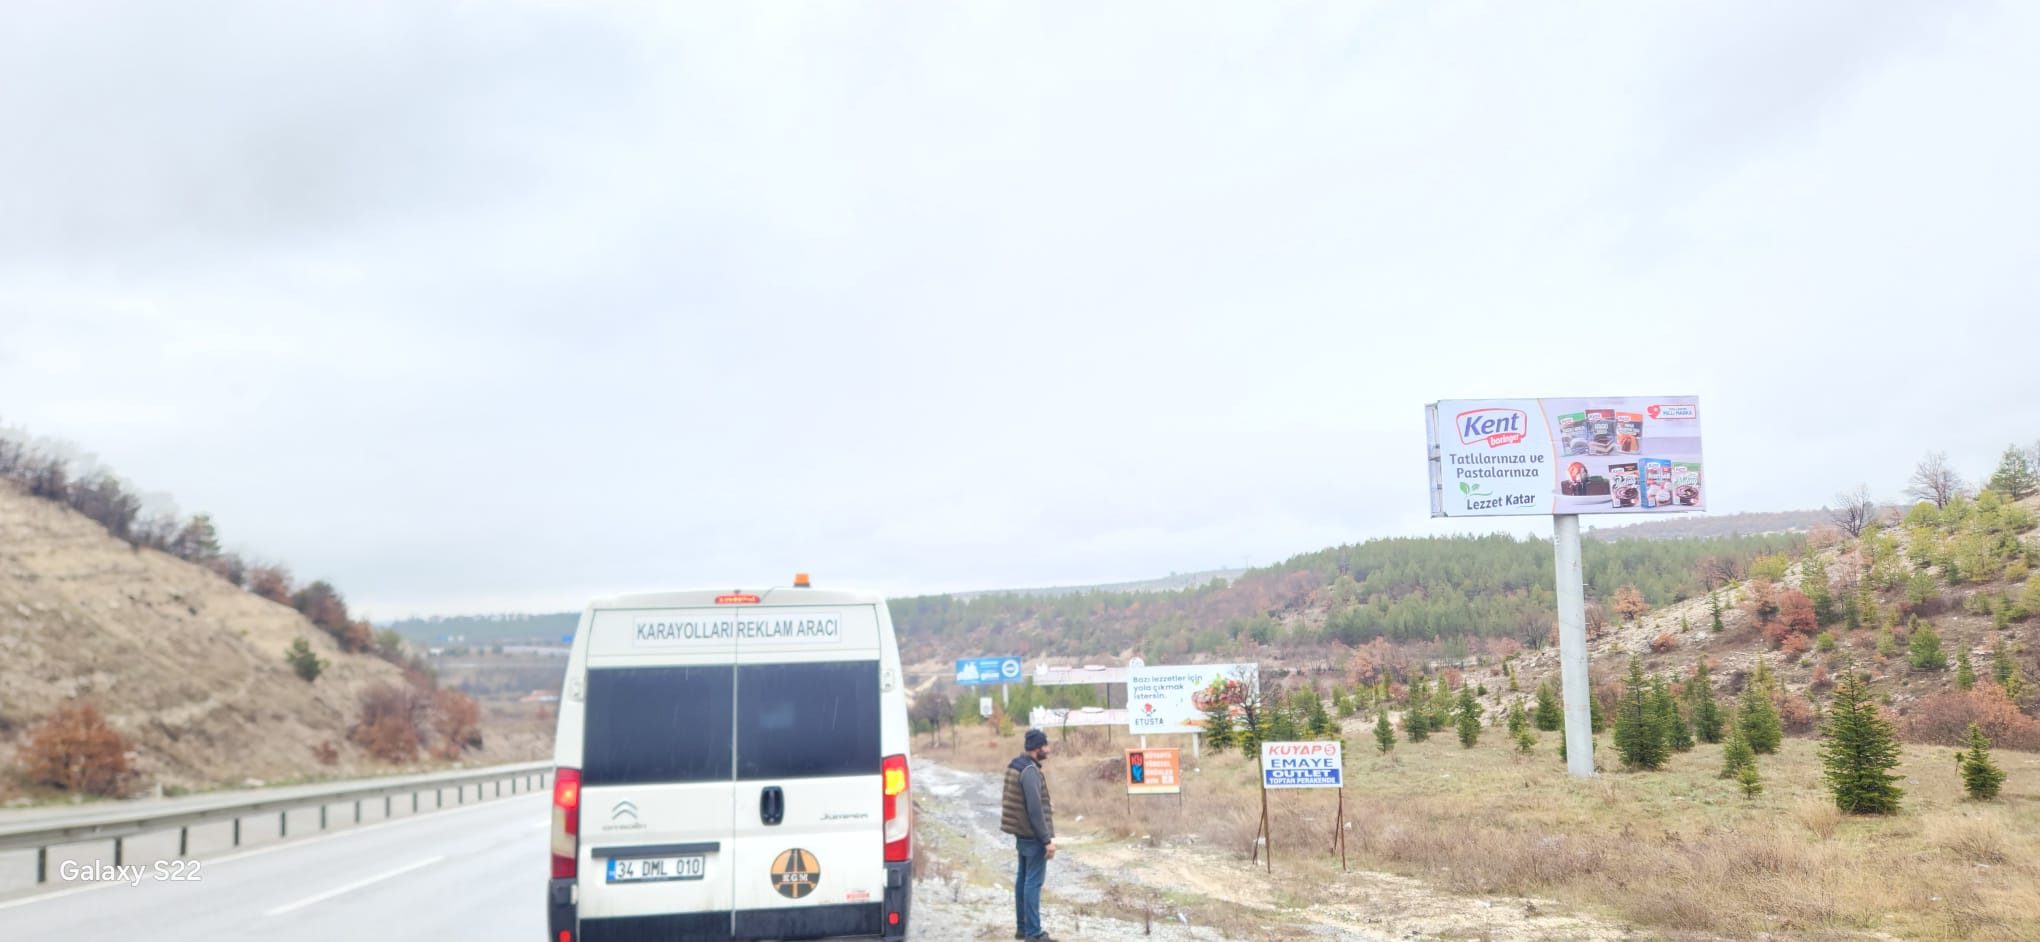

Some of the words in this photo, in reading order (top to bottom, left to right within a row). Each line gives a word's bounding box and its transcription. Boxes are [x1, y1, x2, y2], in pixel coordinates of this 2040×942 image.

[1463, 412, 1519, 437] Kent
[1449, 452, 1526, 465] Tatlılarınıza
[1529, 454, 1544, 463] ve
[1456, 466, 1539, 479] Pastalarınıza
[1466, 496, 1503, 510] Lezzet
[1505, 493, 1536, 506] Katar
[637, 621, 734, 640] KARAYOLLARI
[736, 620, 793, 638] REKLAM
[797, 618, 838, 637] ARACI
[1268, 745, 1322, 756] KUYAP
[1271, 758, 1333, 768] EMAYE
[1272, 769, 1332, 778] OUTLET
[1269, 777, 1296, 785] TOPTAN
[1297, 777, 1336, 785] PERAKENDE
[617, 861, 634, 878] 34
[642, 860, 668, 877] DML
[676, 858, 701, 875] 010
